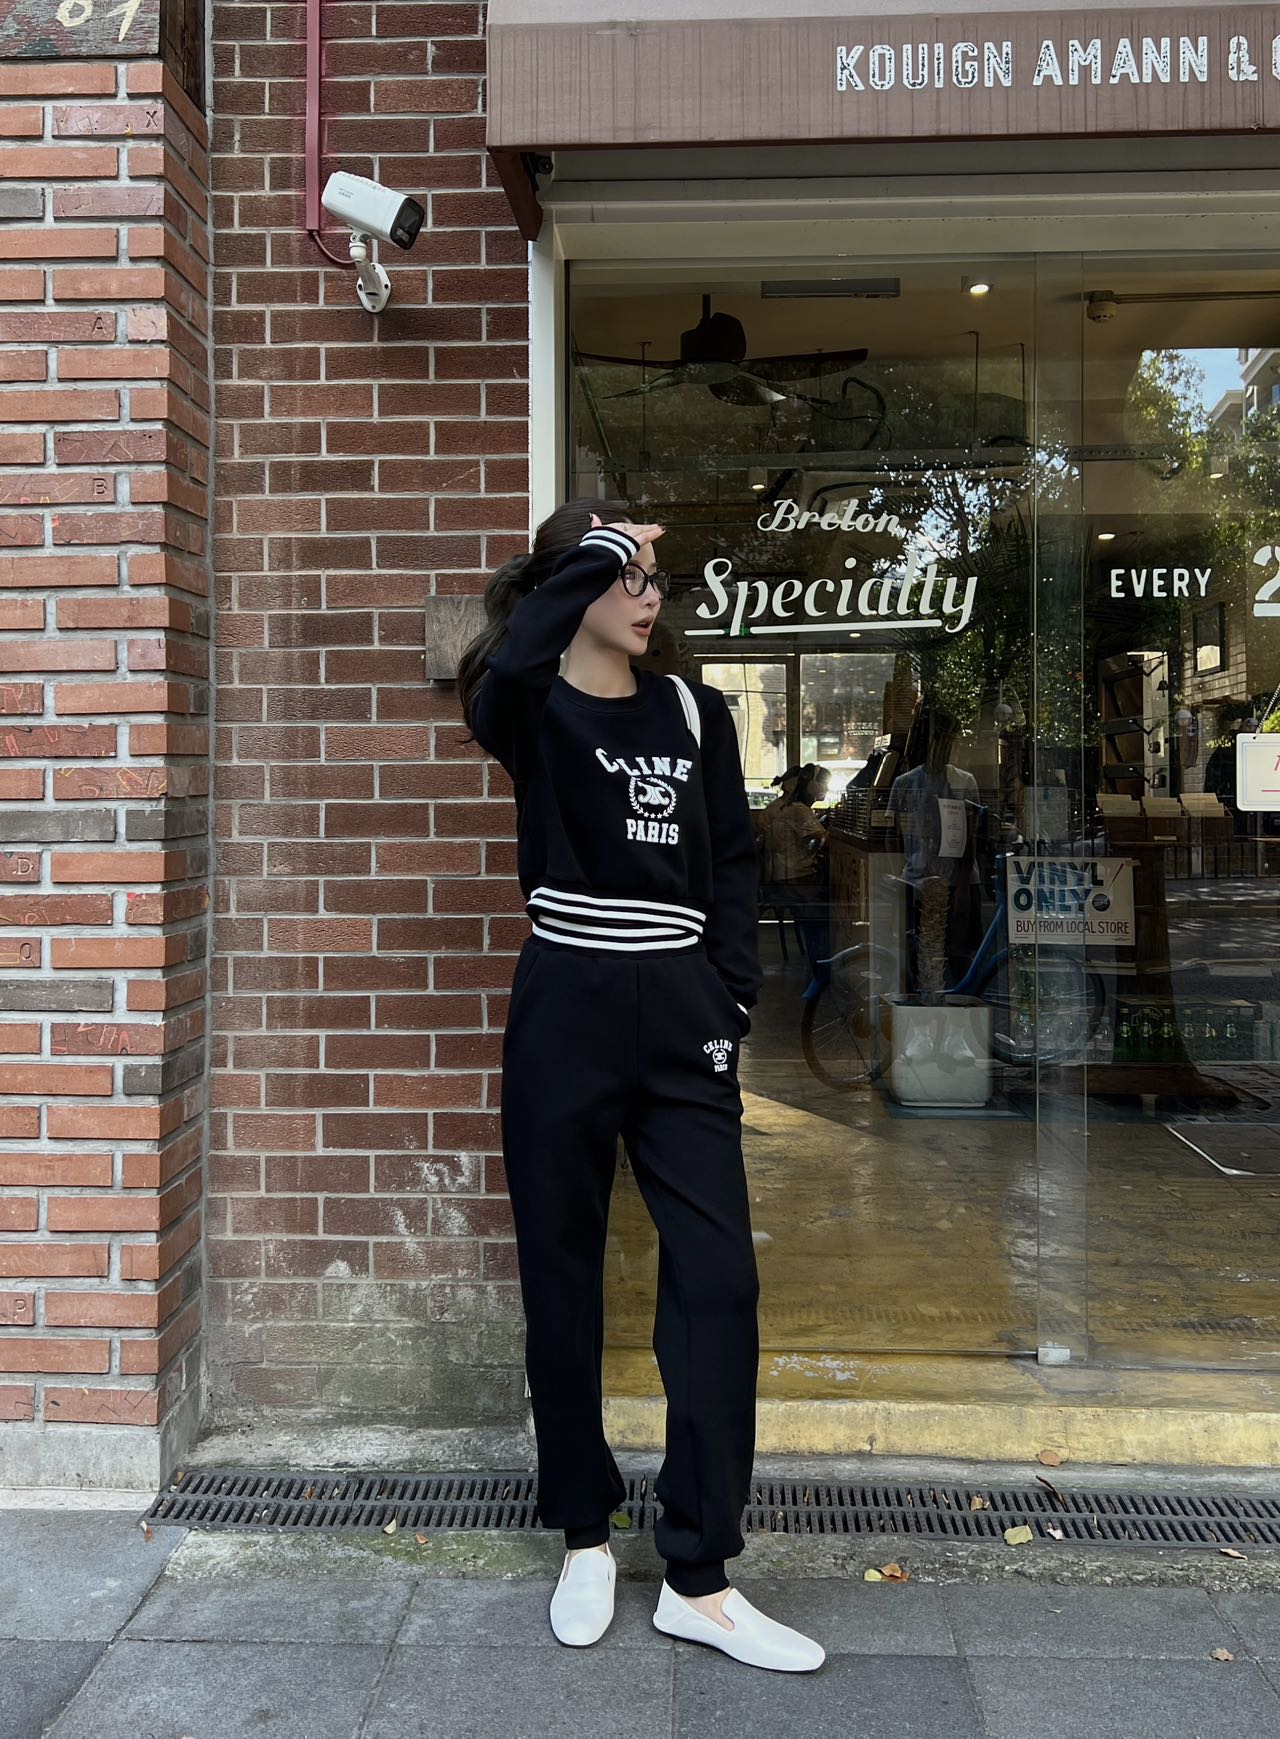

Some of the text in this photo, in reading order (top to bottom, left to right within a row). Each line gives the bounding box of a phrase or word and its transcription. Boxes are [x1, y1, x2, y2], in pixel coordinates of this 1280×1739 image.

[836, 41, 1012, 91] KOUIGN
[1032, 36, 1208, 85] AMANN
[1228, 35, 1258, 81] &
[757, 498, 901, 533] Breton
[695, 551, 978, 637] Specialty
[1110, 568, 1212, 598] EVERY
[626, 818, 679, 845] PARIS
[1013, 861, 1104, 886] VINYL
[1013, 887, 1093, 912] ONLY
[1016, 920, 1129, 935] BUY FROM LOCAL STORE
